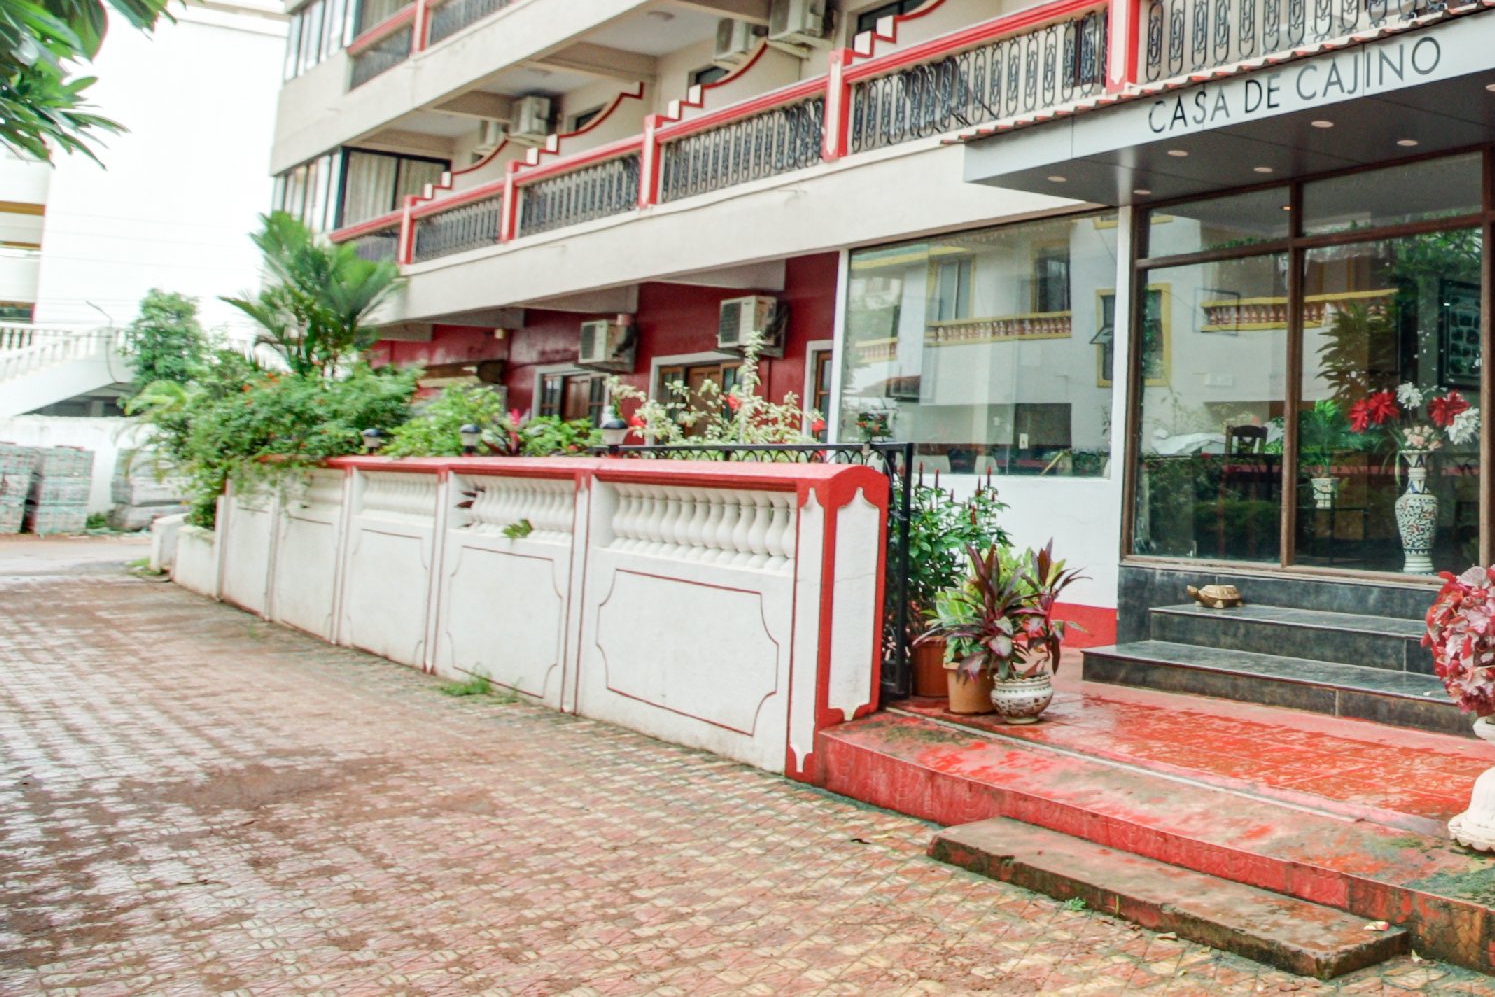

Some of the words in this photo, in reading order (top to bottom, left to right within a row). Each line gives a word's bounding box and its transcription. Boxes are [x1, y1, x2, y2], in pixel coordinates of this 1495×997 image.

[1148, 87, 1231, 134] CASA
[1244, 73, 1282, 114] DE
[1296, 36, 1442, 101] CAJINO
